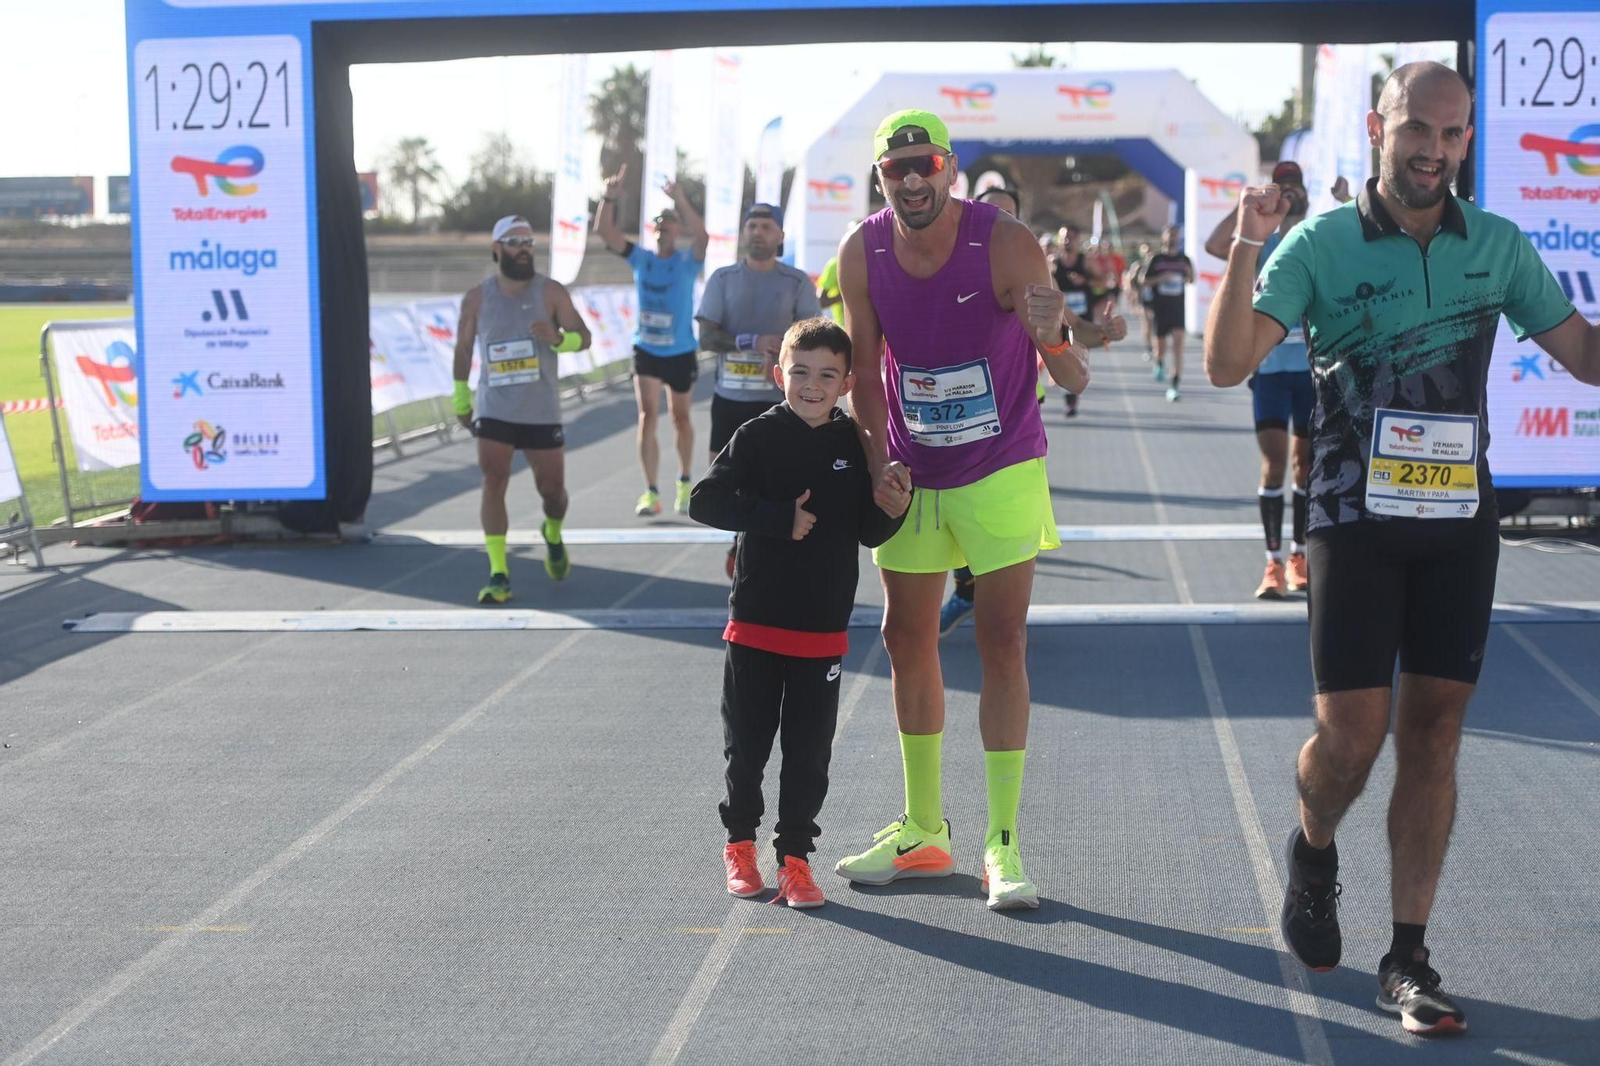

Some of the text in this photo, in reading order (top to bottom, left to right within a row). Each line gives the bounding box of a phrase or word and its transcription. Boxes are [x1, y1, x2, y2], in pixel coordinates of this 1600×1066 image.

[145, 61, 290, 131] 1:29:21
[1519, 186, 1600, 204] TotalEnerg
[171, 207, 267, 223] TotalEnergies
[169, 239, 277, 276] málaga
[1327, 289, 1414, 321] TURDETANIA
[206, 371, 285, 390] CaixaBank
[929, 403, 966, 421] 372
[936, 422, 965, 431] PINFLOW
[1388, 443, 1424, 453] TotalEnergies
[1440, 448, 1460, 456] MÁLAGA
[1441, 441, 1464, 449] MARATÓN
[1398, 463, 1452, 486] 2370
[1397, 488, 1450, 498] MARTÍN Y PAPÁ
